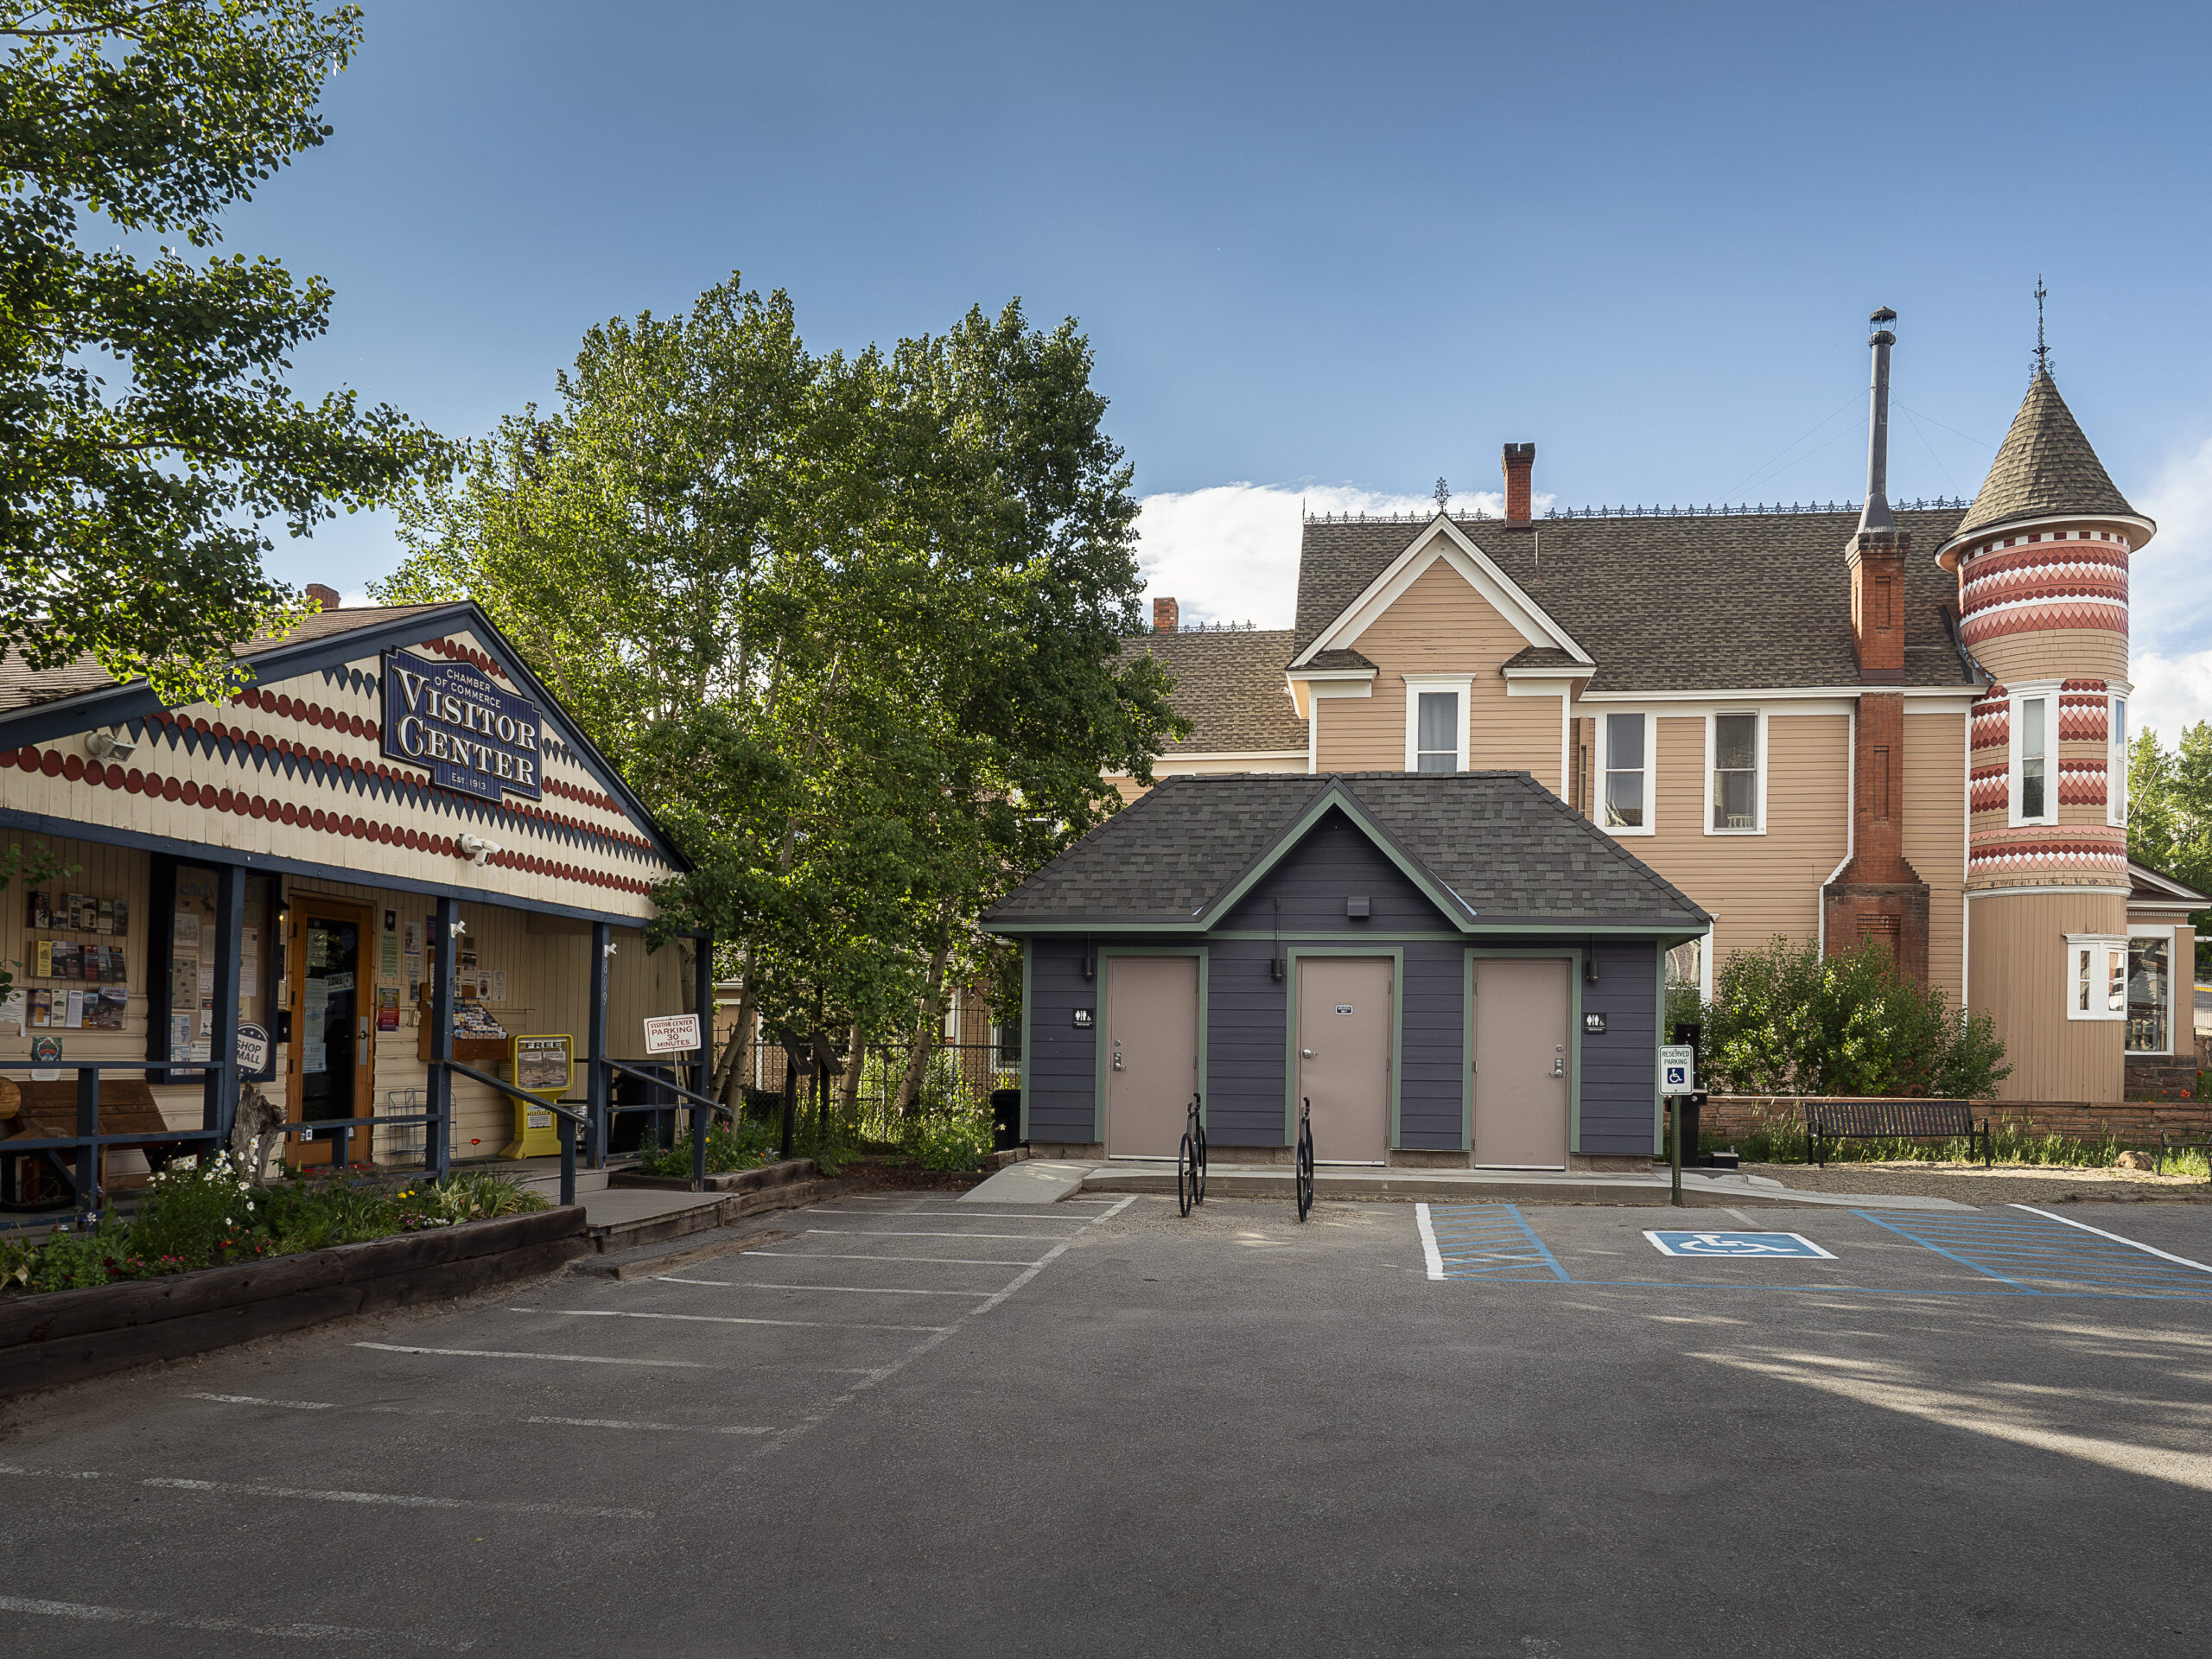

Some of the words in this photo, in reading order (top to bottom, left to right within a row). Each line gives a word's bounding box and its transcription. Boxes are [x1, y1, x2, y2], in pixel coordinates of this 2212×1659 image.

[435, 676, 448, 688] OF
[451, 683, 501, 709] COMMERCE
[446, 669, 491, 693] CHAMBER
[392, 665, 537, 752] VISITOR
[397, 714, 535, 787] CENTER
[469, 779, 486, 790] 1913
[652, 1026, 693, 1035] PARKING
